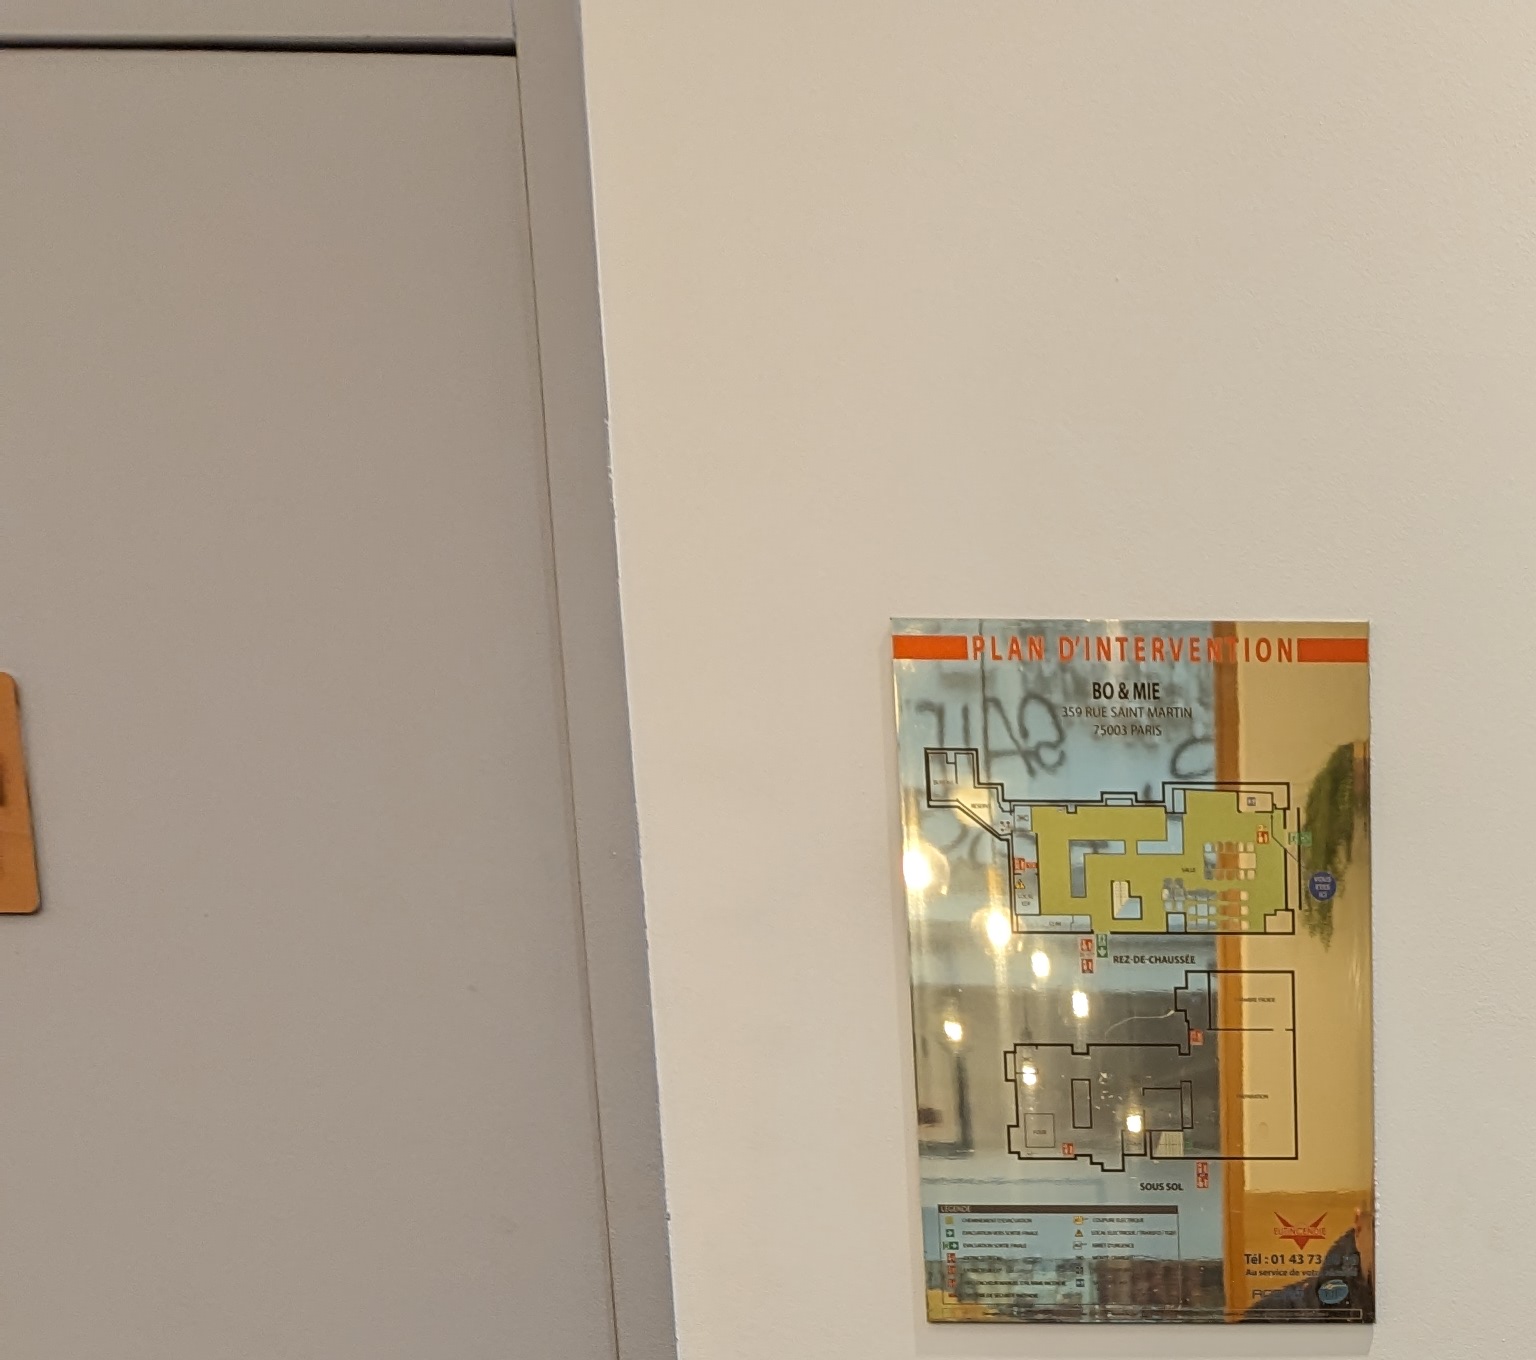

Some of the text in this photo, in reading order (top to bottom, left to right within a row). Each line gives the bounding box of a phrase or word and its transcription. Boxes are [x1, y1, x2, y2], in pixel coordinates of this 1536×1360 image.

[972, 635, 1292, 662] PLAN D'INTERVENTION
[1092, 682, 1160, 700] BO & MIE
[1062, 706, 1193, 718] 359 RUE SAINT MARTIN
[1093, 724, 1162, 736] 75003 PARIS
[1113, 954, 1196, 965] REZ-DE-CHAUSSÉE
[1140, 1182, 1184, 1191] SOUS SOL
[1244, 1254, 1262, 1265] Tél
[1271, 1254, 1285, 1265] 01
[1288, 1254, 1304, 1265] 43
[1307, 1254, 1322, 1265] 73
[1245, 1268, 1257, 1276] Au
[1259, 1268, 1287, 1276] service
[1289, 1268, 1299, 1276] de
